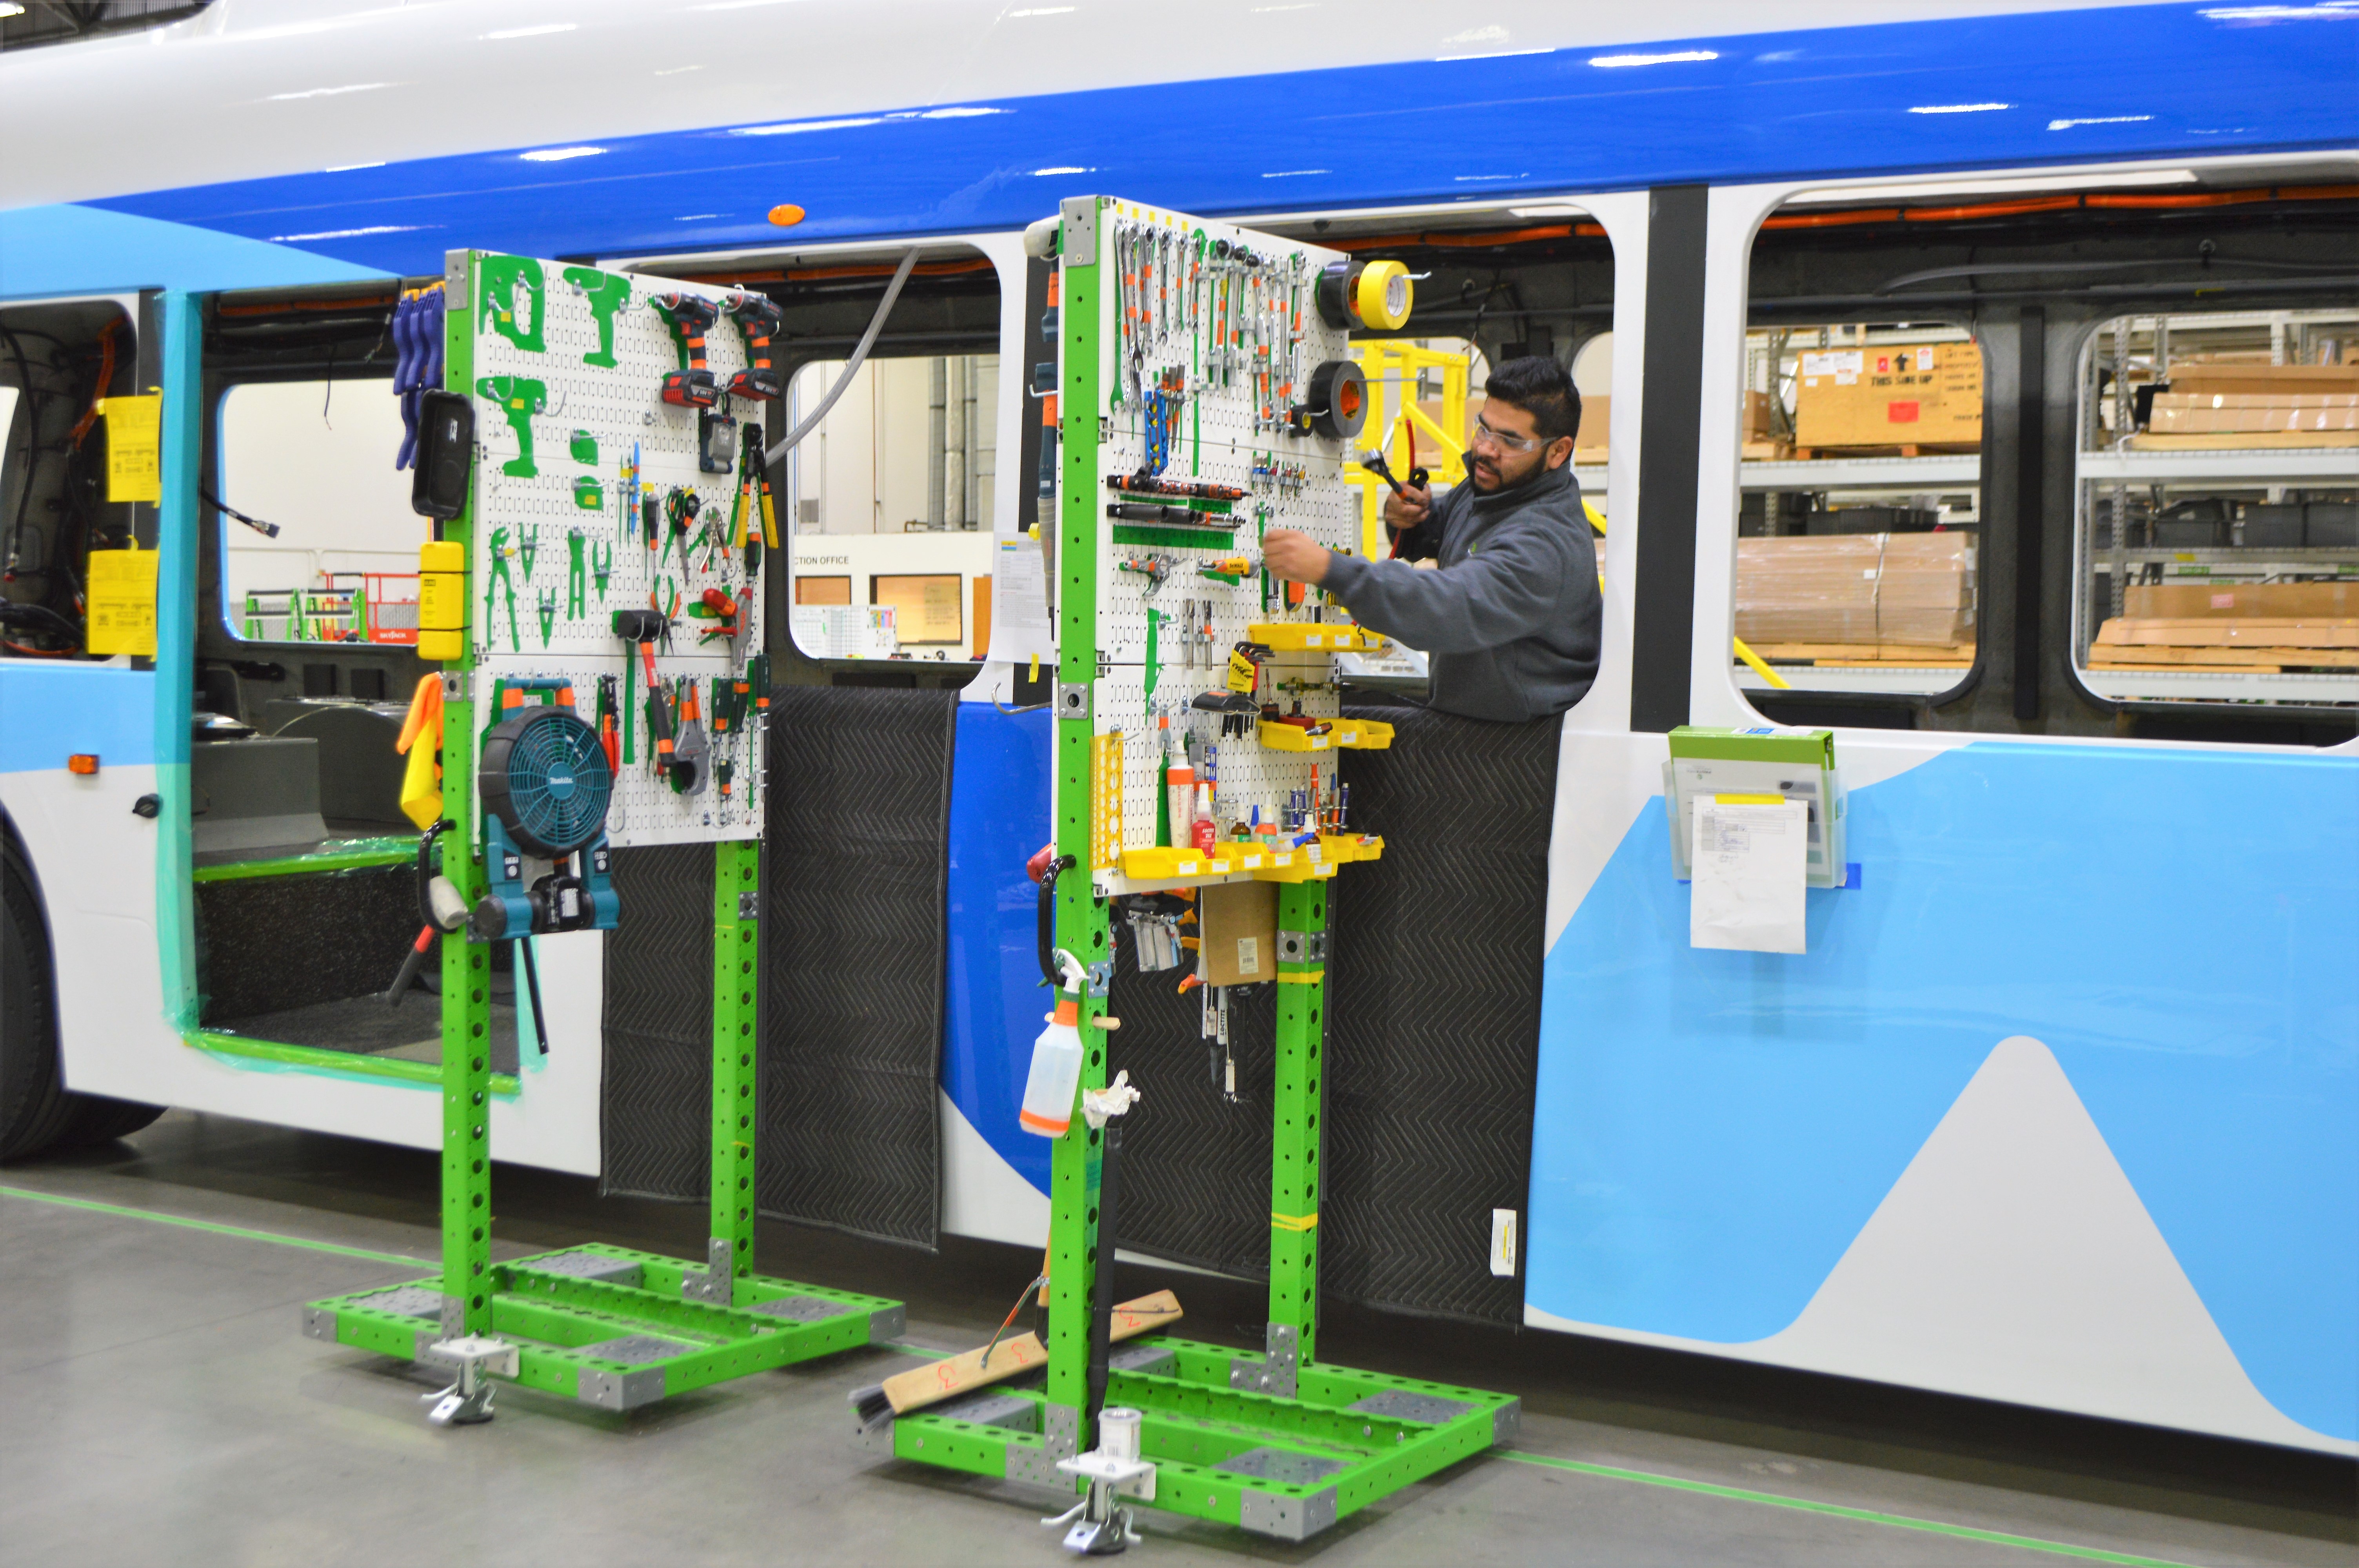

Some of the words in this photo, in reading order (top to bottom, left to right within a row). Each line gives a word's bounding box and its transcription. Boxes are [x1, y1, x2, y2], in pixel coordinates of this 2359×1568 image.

[1872, 376, 1892, 386] THIS
[1896, 375, 1915, 385] SIDE
[1919, 374, 1932, 384] UP
[820, 556, 849, 564] OFFICE
